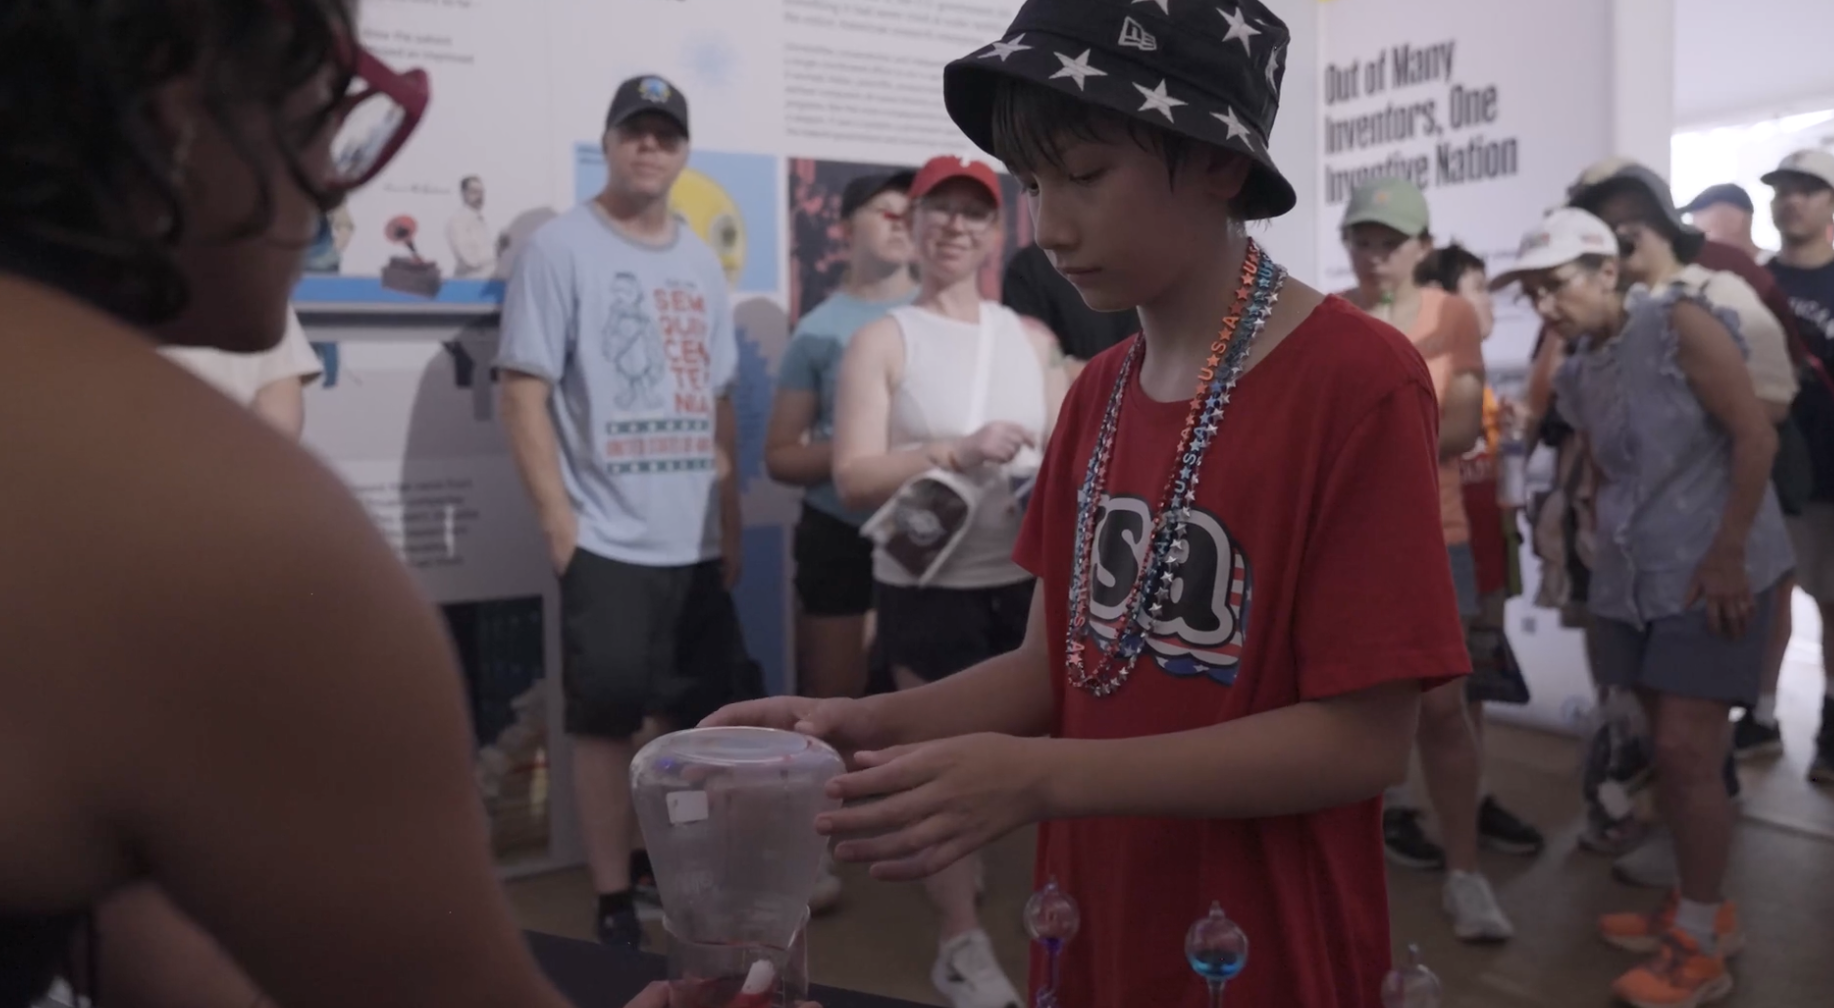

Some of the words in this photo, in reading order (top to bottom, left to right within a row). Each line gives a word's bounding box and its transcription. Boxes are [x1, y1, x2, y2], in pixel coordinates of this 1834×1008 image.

[1325, 63, 1359, 105] Out
[1364, 49, 1386, 96] of
[1392, 41, 1455, 88] Many
[1325, 100, 1443, 154] Inventors,
[1450, 84, 1498, 130] One
[1436, 135, 1518, 187] Nation
